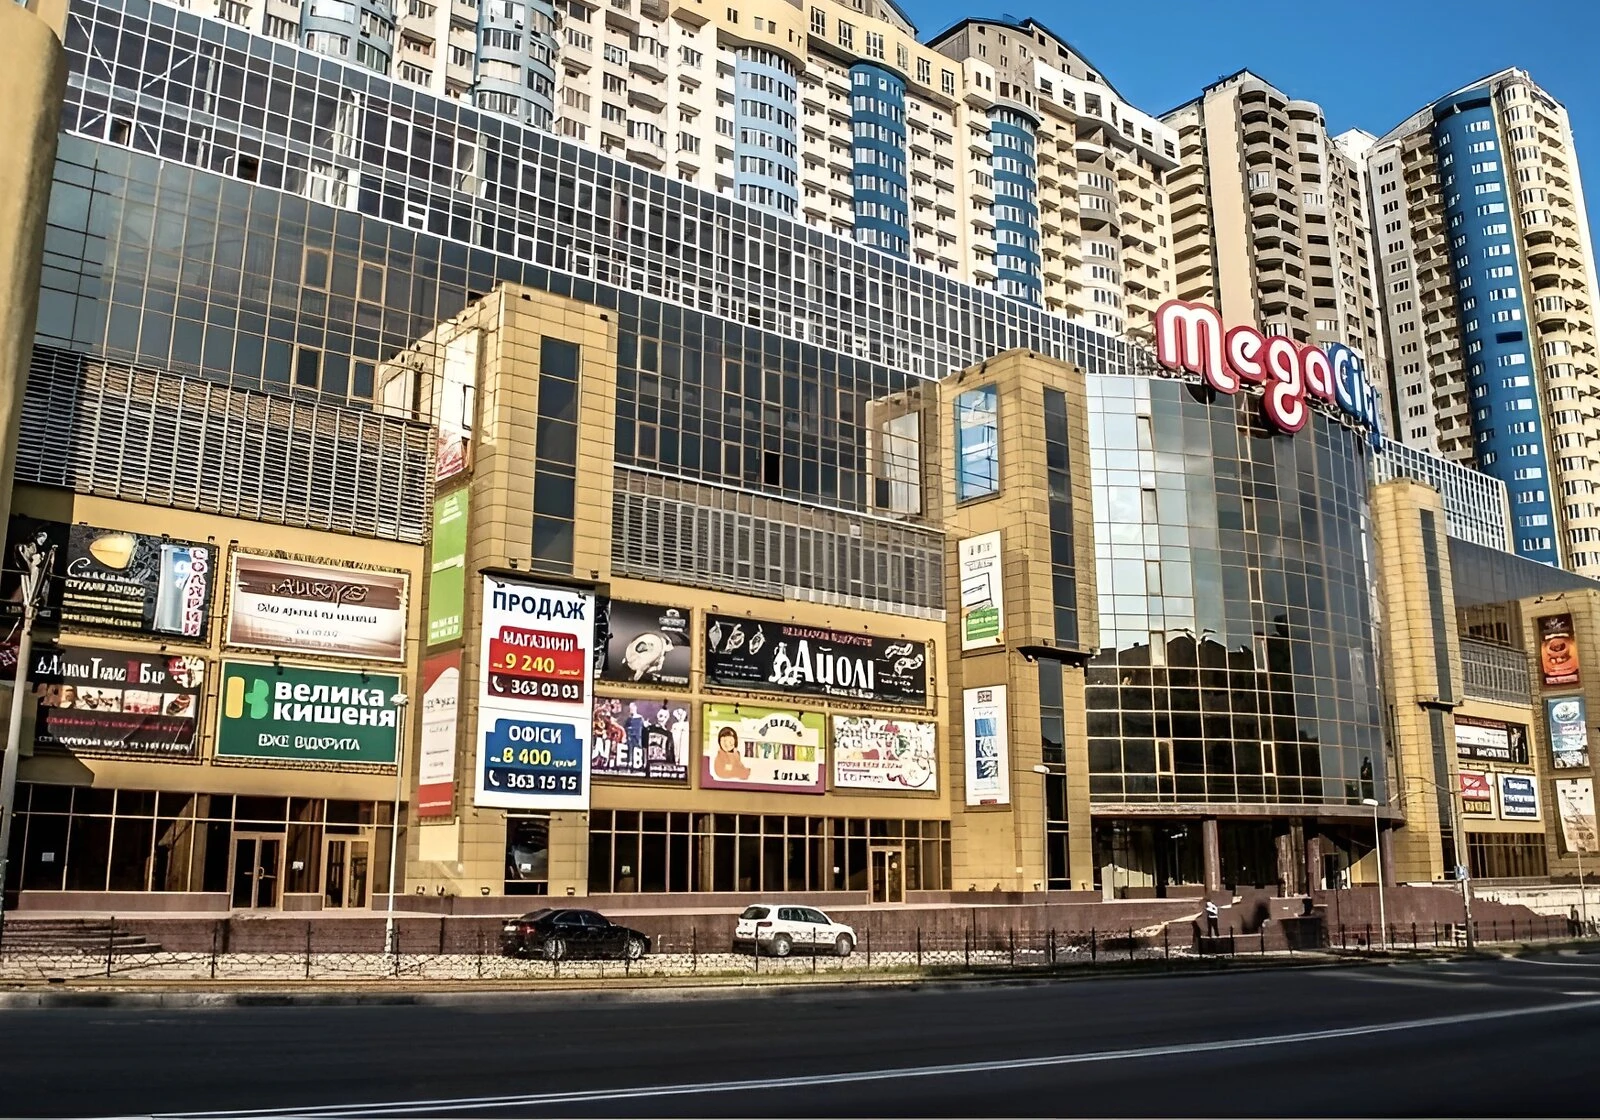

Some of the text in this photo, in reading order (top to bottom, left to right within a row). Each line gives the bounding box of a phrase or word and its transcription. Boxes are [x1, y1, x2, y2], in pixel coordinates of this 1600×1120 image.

[493, 590, 586, 620] ПРОДАЖ
[505, 653, 517, 669] 9
[521, 655, 555, 673] 240
[274, 681, 385, 707] велика
[541, 683, 559, 697] 03
[562, 684, 579, 699] 03
[273, 702, 396, 728] кишеня
[508, 725, 562, 745] ОФІСИ
[502, 747, 514, 763] 8
[519, 749, 552, 765] 400
[507, 773, 577, 790] 363 15 15
